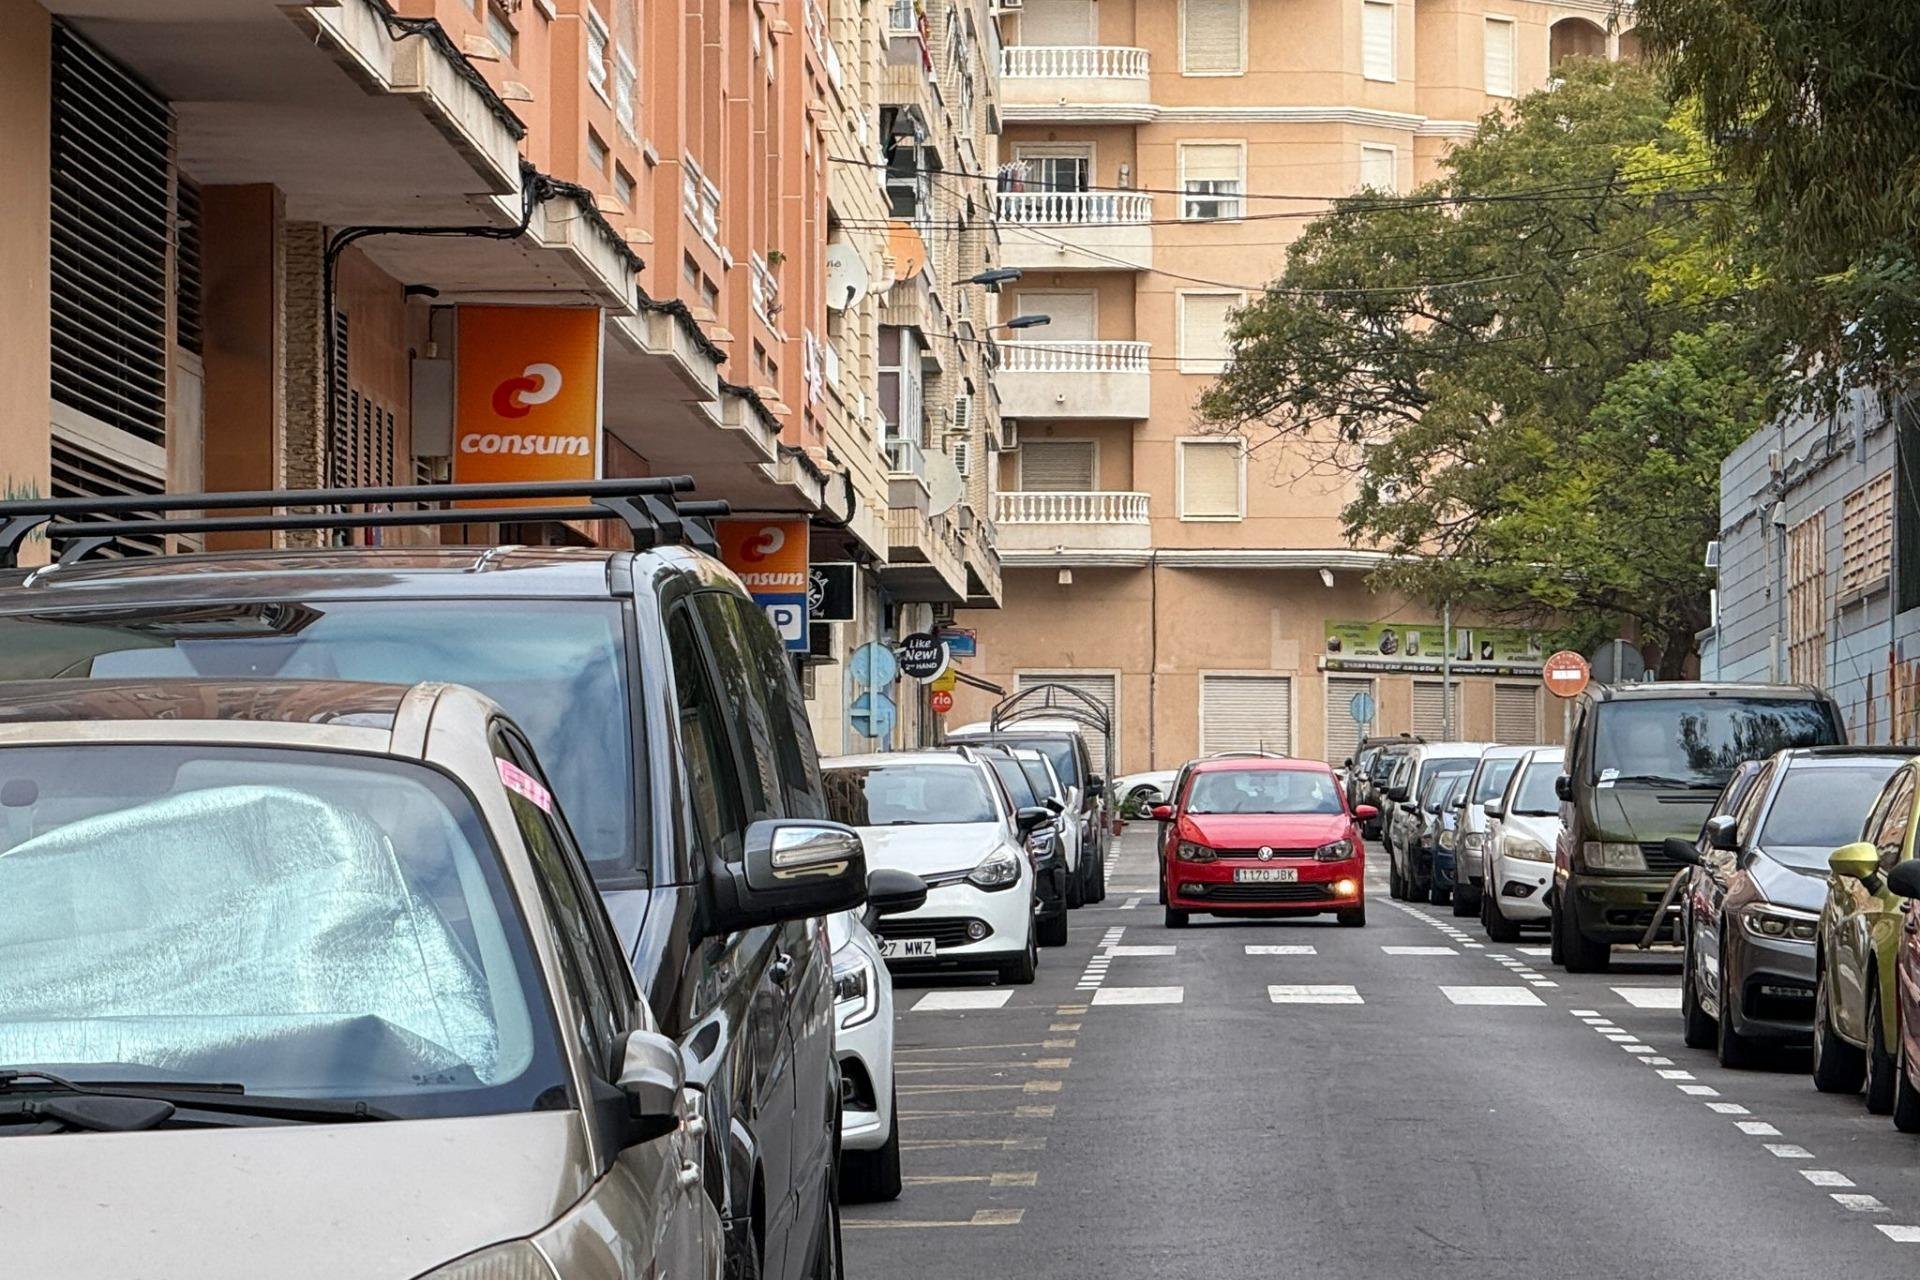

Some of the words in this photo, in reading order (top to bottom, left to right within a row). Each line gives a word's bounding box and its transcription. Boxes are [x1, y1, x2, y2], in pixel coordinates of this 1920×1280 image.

[461, 433, 590, 456] consum
[737, 572, 805, 586] onsum
[909, 639, 931, 649] Like
[904, 647, 938, 661] New!
[916, 662, 937, 670] HAND
[932, 692, 952, 704] ria
[1243, 870, 1270, 880] 1170
[1273, 870, 1294, 880] JBK
[904, 941, 932, 955] MWZ
